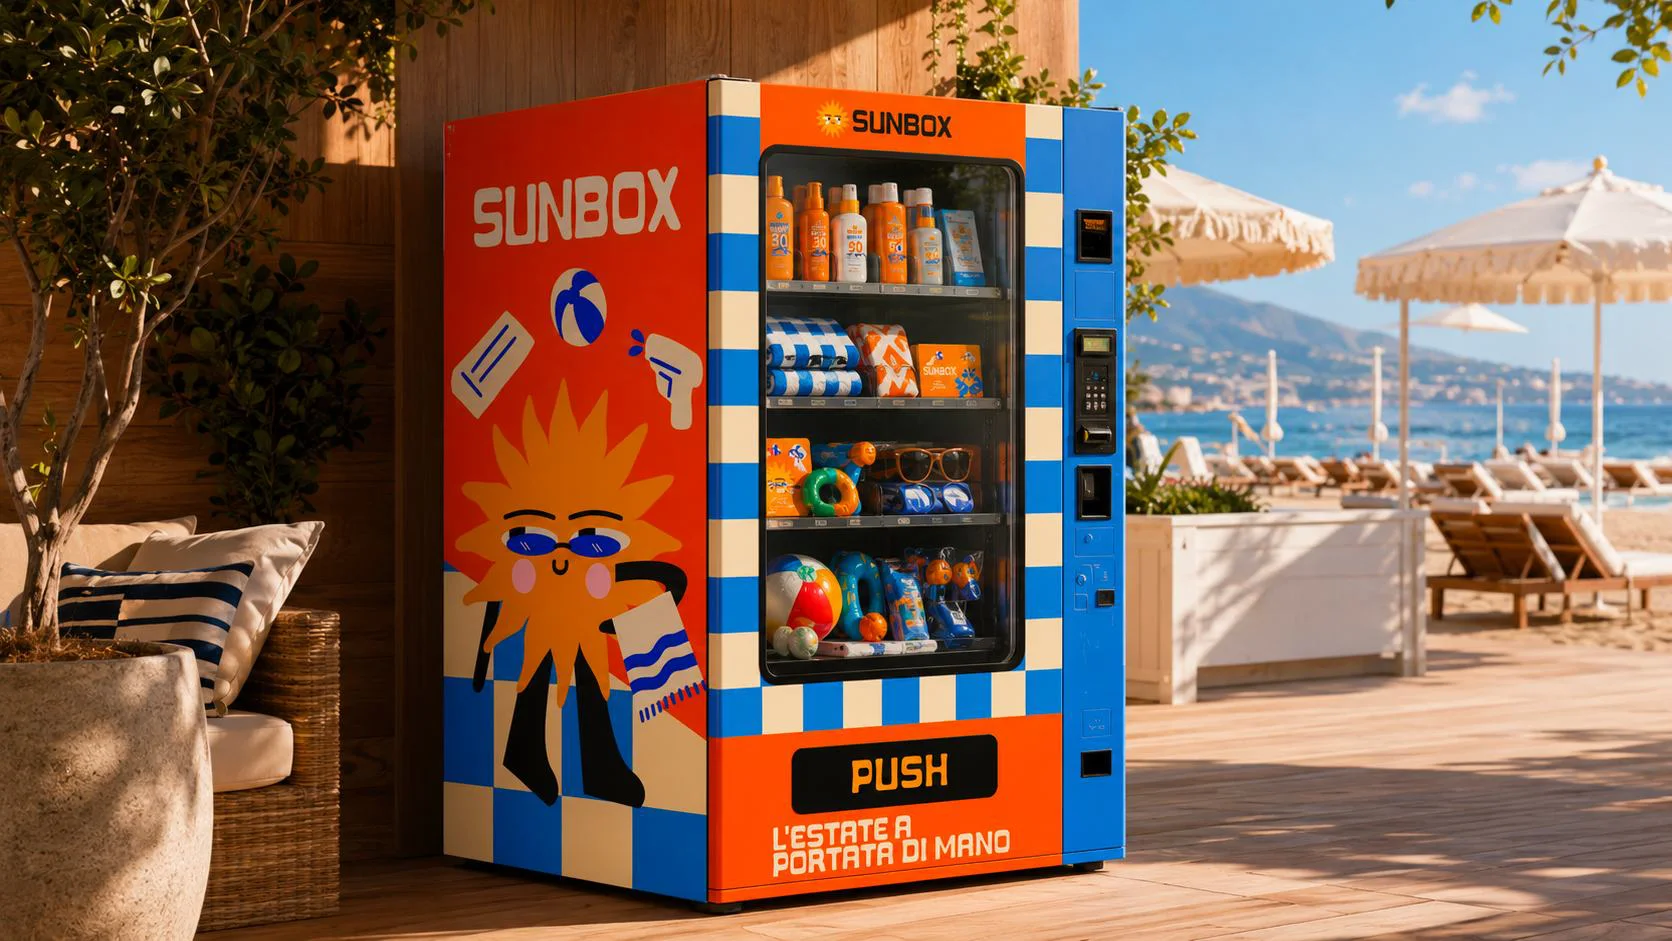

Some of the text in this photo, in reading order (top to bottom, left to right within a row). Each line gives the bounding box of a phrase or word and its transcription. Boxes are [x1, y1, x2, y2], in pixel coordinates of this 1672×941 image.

[852, 109, 952, 138] SUNBOX
[473, 166, 681, 248] SUNBOX
[851, 753, 948, 794] PUSH
[772, 815, 912, 851] L'ESTATE A
[772, 829, 1011, 877] PORTATA DI MANO
